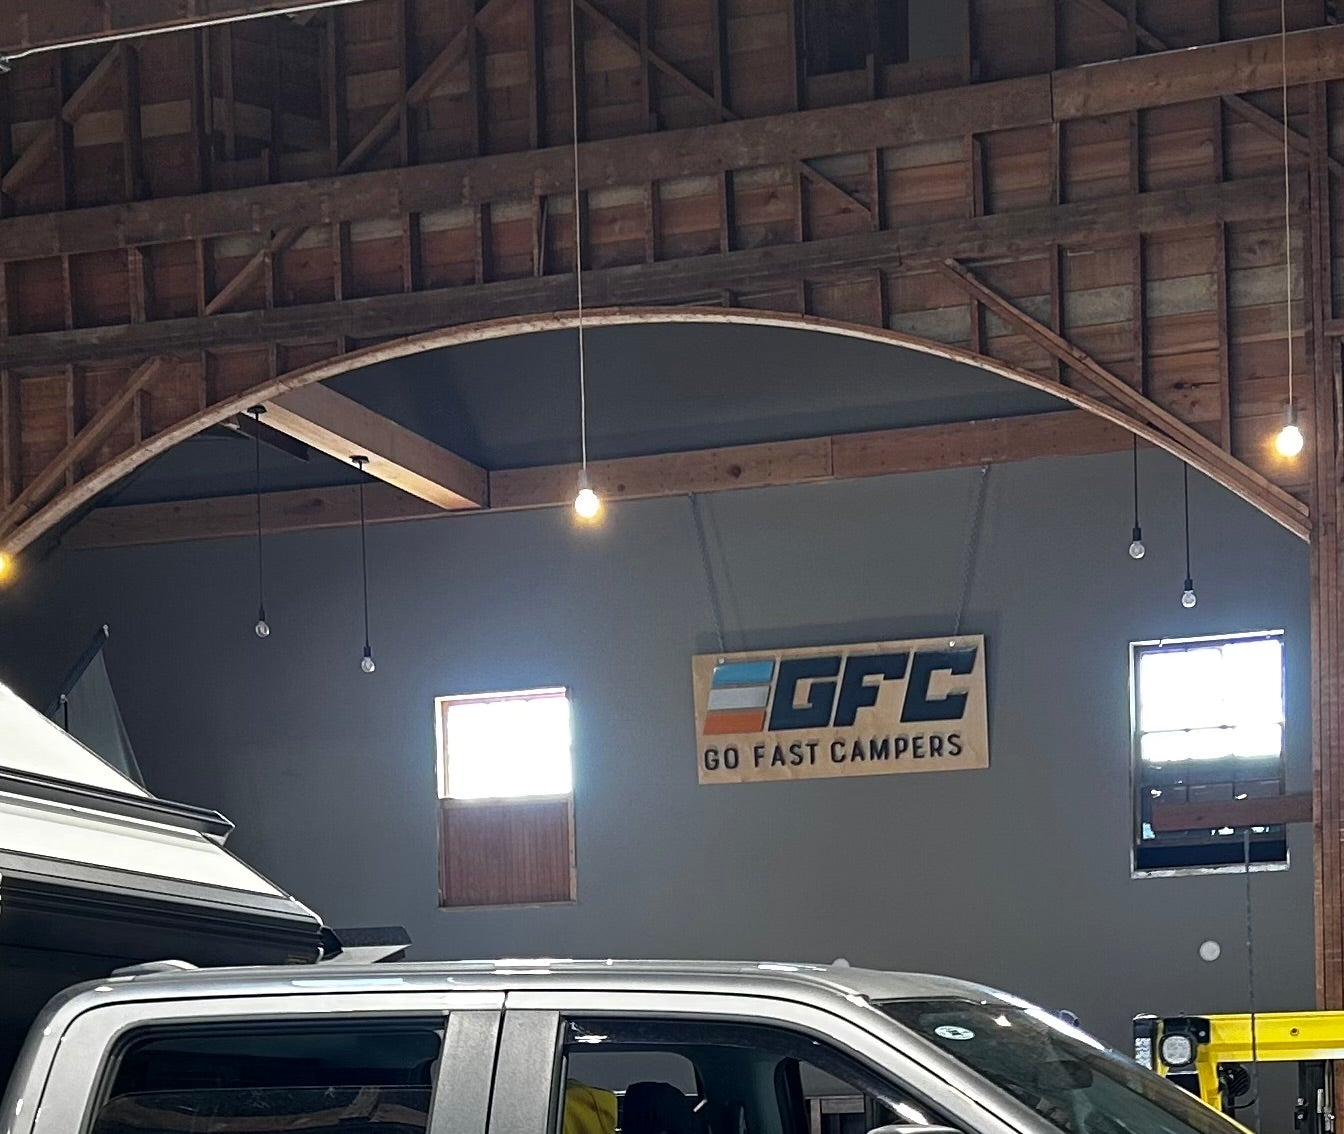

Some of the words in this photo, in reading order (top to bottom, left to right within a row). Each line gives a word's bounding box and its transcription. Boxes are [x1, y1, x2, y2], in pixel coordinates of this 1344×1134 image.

[767, 646, 978, 729] GFC
[703, 747, 740, 771] GO
[753, 742, 819, 768] FAST
[830, 732, 963, 763] CAMPERS
